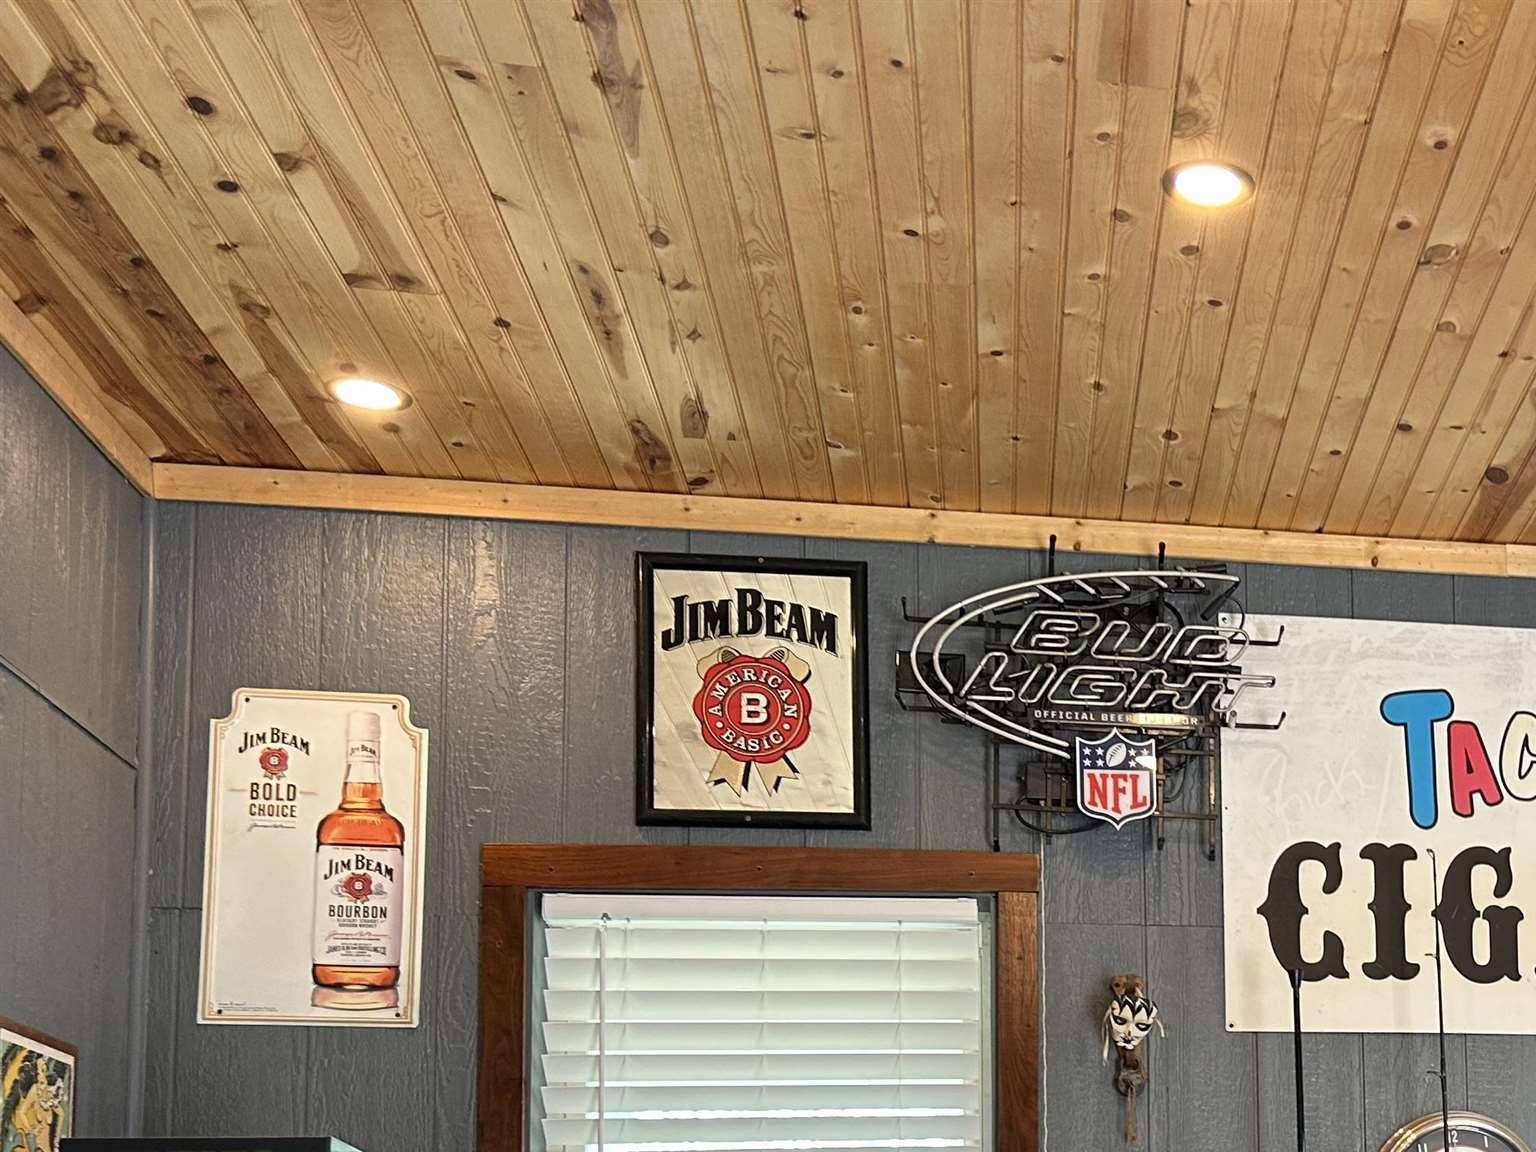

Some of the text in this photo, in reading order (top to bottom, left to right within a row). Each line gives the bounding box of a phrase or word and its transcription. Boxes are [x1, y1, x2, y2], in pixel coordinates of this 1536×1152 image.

[661, 587, 838, 657] JIM BEAM
[1011, 611, 1249, 665] BUD
[707, 668, 798, 718] AMERICAN
[960, 652, 1275, 712] LIGHT
[740, 692, 768, 724] B
[1034, 709, 1095, 721] OFFICIAL
[238, 727, 310, 756] JIM BEAM
[720, 727, 784, 752] BASIC
[250, 782, 297, 802] BOLD
[1088, 772, 1147, 815] NFL
[249, 803, 297, 818] CHOICE
[324, 853, 394, 882] JIM BEAM
[328, 904, 388, 918] BOURBON
[1447, 1130, 1458, 1143] 12
[1484, 1136, 1489, 1148] 1
